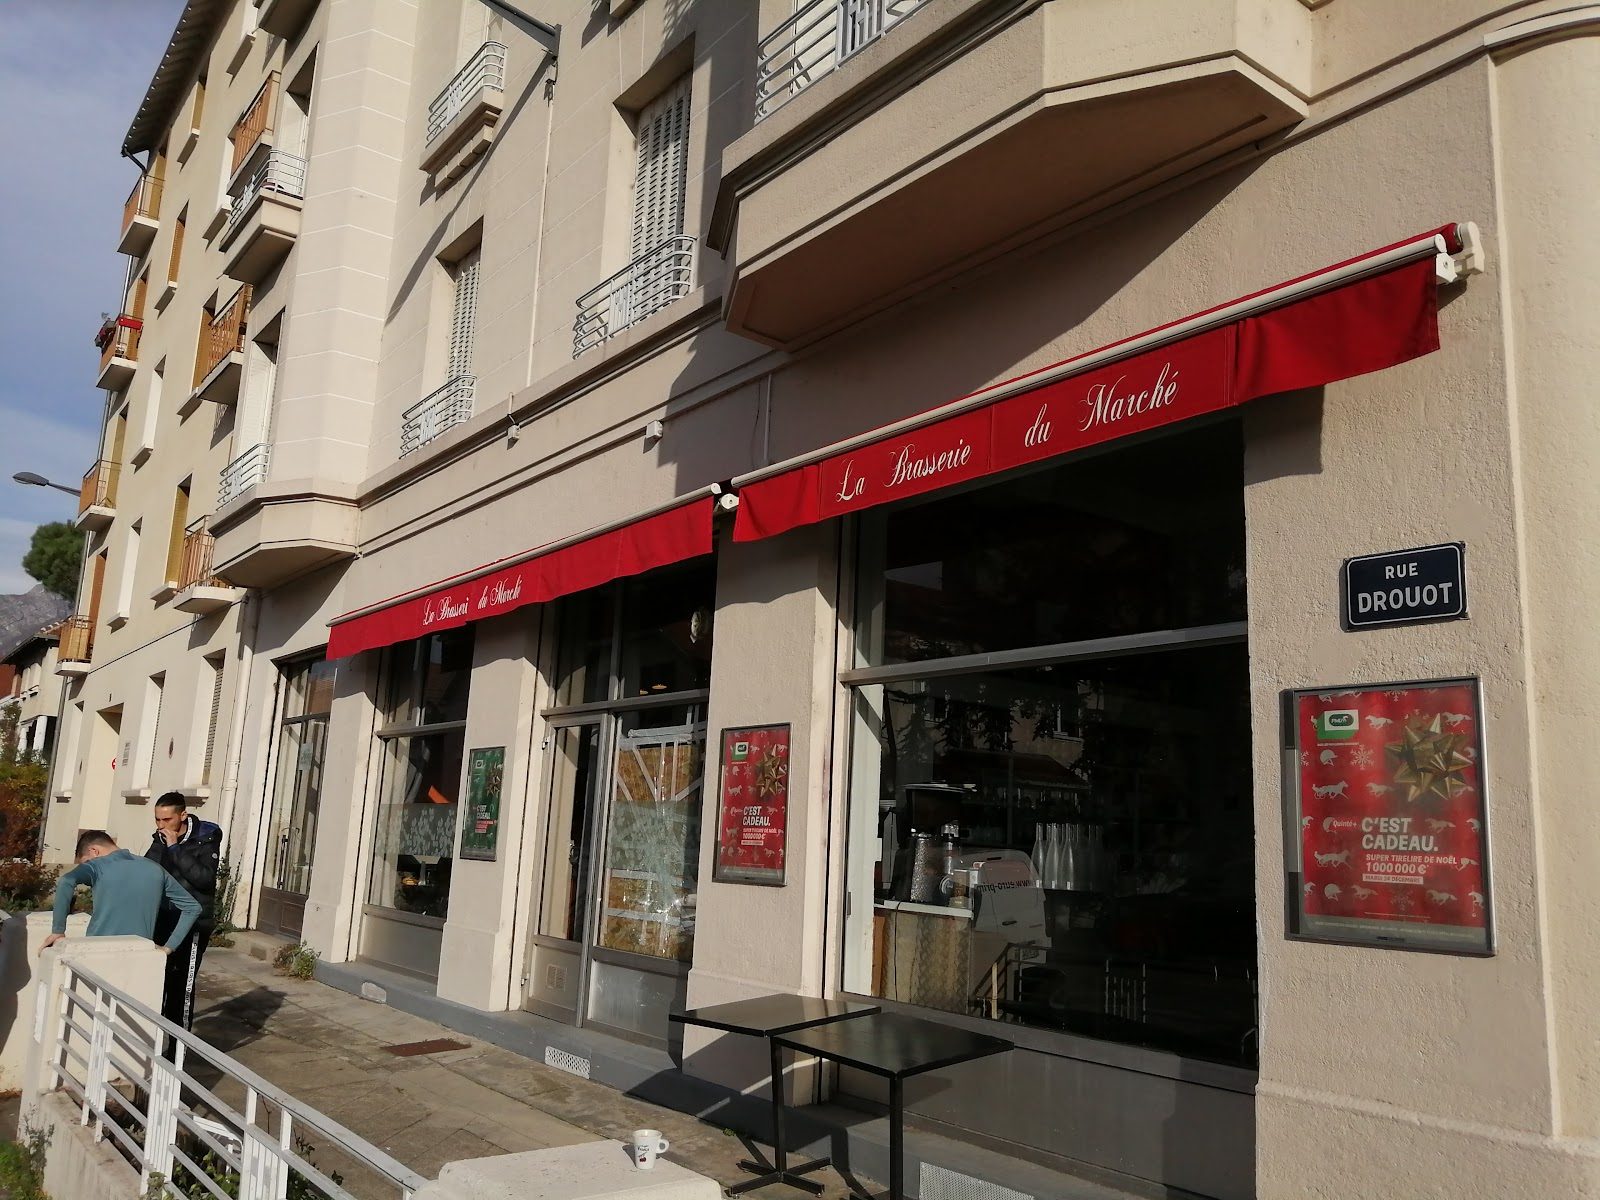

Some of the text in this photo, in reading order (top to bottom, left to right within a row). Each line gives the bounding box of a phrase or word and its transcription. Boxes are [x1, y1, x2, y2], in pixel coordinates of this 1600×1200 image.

[835, 362, 1180, 503] La Brasserie du Marché
[1385, 562, 1419, 580] RUE
[1357, 582, 1454, 614] DROUOT
[437, 597, 469, 620] Brasseri
[1362, 817, 1412, 833] C'EST
[1362, 835, 1439, 852] CADEAU.
[1366, 853, 1458, 865] SUPER TIRELIRE DE NOËL
